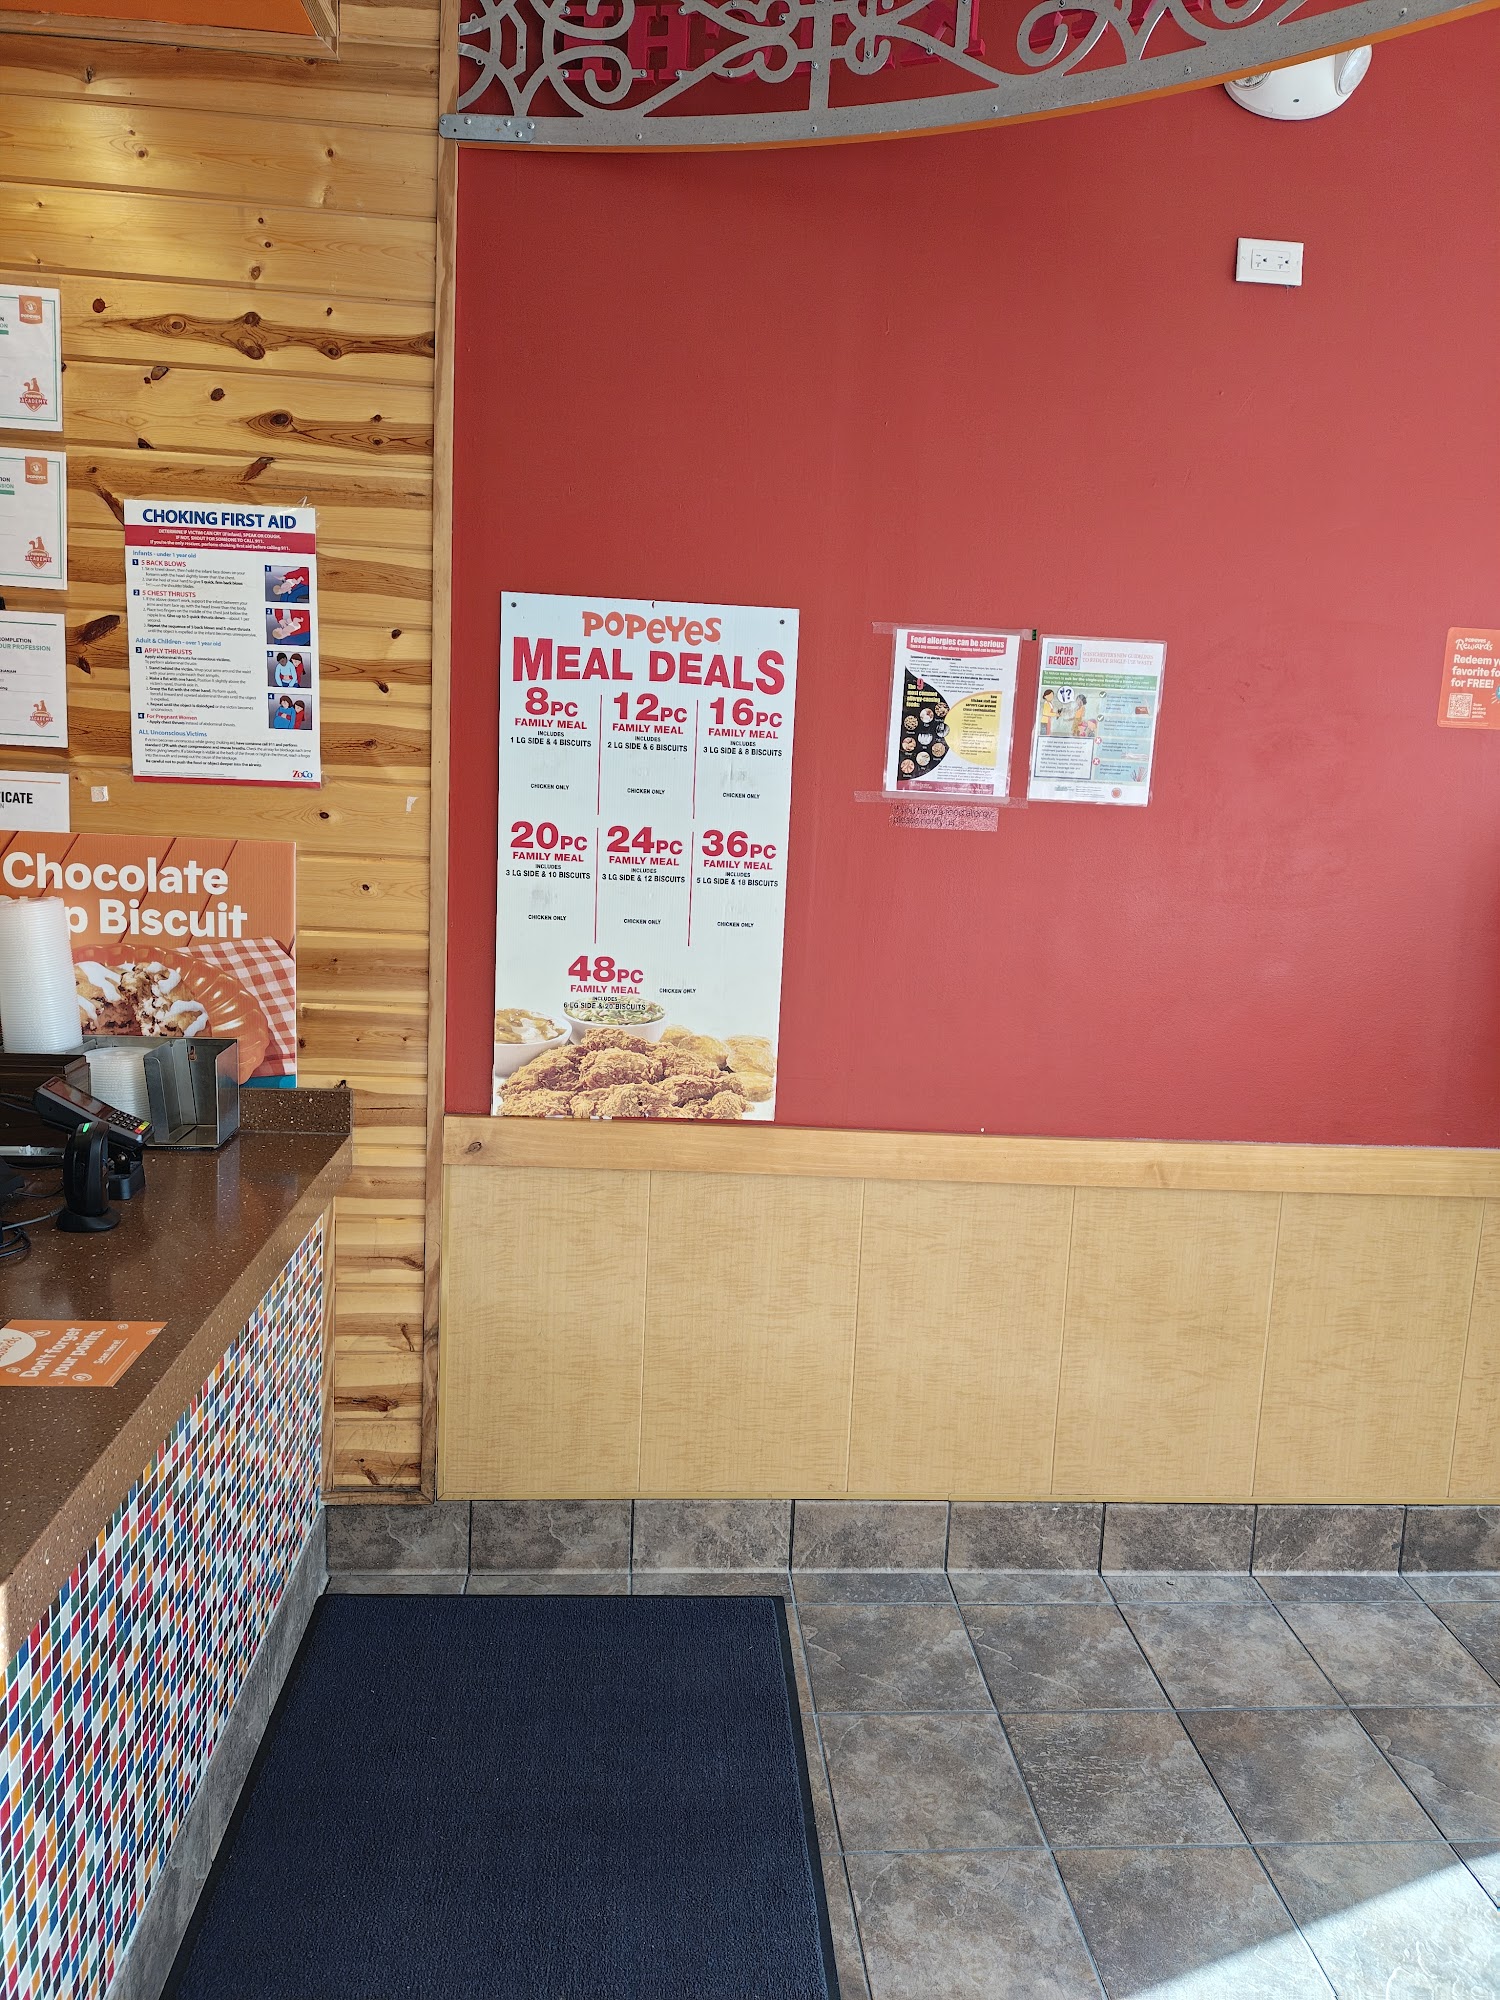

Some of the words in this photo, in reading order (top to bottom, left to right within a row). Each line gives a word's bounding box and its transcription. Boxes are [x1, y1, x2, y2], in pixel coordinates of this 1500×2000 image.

[143, 509, 218, 525] CHOKING
[222, 513, 264, 527] FIRST
[268, 515, 297, 529] AID
[911, 636, 926, 644] Food
[927, 637, 956, 645] allergies
[1456, 639, 1494, 651] Rewards
[1055, 645, 1074, 656] UPON
[512, 636, 634, 682] MEAL
[649, 650, 785, 695] DEALS
[1048, 655, 1079, 667] REQUEST
[1454, 654, 1492, 665] Redeem
[1452, 666, 1490, 677] favorite
[916, 678, 924, 690] 9
[1451, 678, 1466, 687] for
[1467, 679, 1494, 689] FREE!
[526, 687, 578, 717] 8PC
[614, 692, 687, 723] 12PC
[710, 697, 782, 728] 16PC
[515, 718, 554, 727] FAMILY
[558, 720, 587, 730] MEAL
[613, 723, 650, 733] FAMILY
[654, 726, 683, 734] MEAL
[709, 728, 746, 737] FAMILY
[750, 730, 778, 739] MEAL
[560, 739, 592, 747] BISCUITS
[656, 744, 688, 752] BISCUITS
[752, 749, 782, 757] BISCUITS
[292, 770, 313, 779] ZoCo
[510, 821, 587, 851] 20PC
[607, 826, 683, 855] 24PC
[702, 830, 776, 859] 36PC
[513, 852, 551, 861] FAMILY
[555, 854, 584, 862] MEAL
[610, 856, 647, 865] FAMILY
[650, 858, 679, 866] MEAL
[704, 860, 740, 869] FAMILY
[744, 862, 773, 870] MEAL
[3, 851, 229, 895] Chocolate
[99, 899, 248, 938] Biscuit
[568, 956, 644, 984] 48PC
[571, 985, 608, 993] FAMILY
[611, 986, 640, 994] MEAL
[19, 1354, 57, 1378] Don't
[44, 1327, 83, 1353] forget
[49, 1356, 78, 1377] your
[70, 1328, 107, 1356] points.
